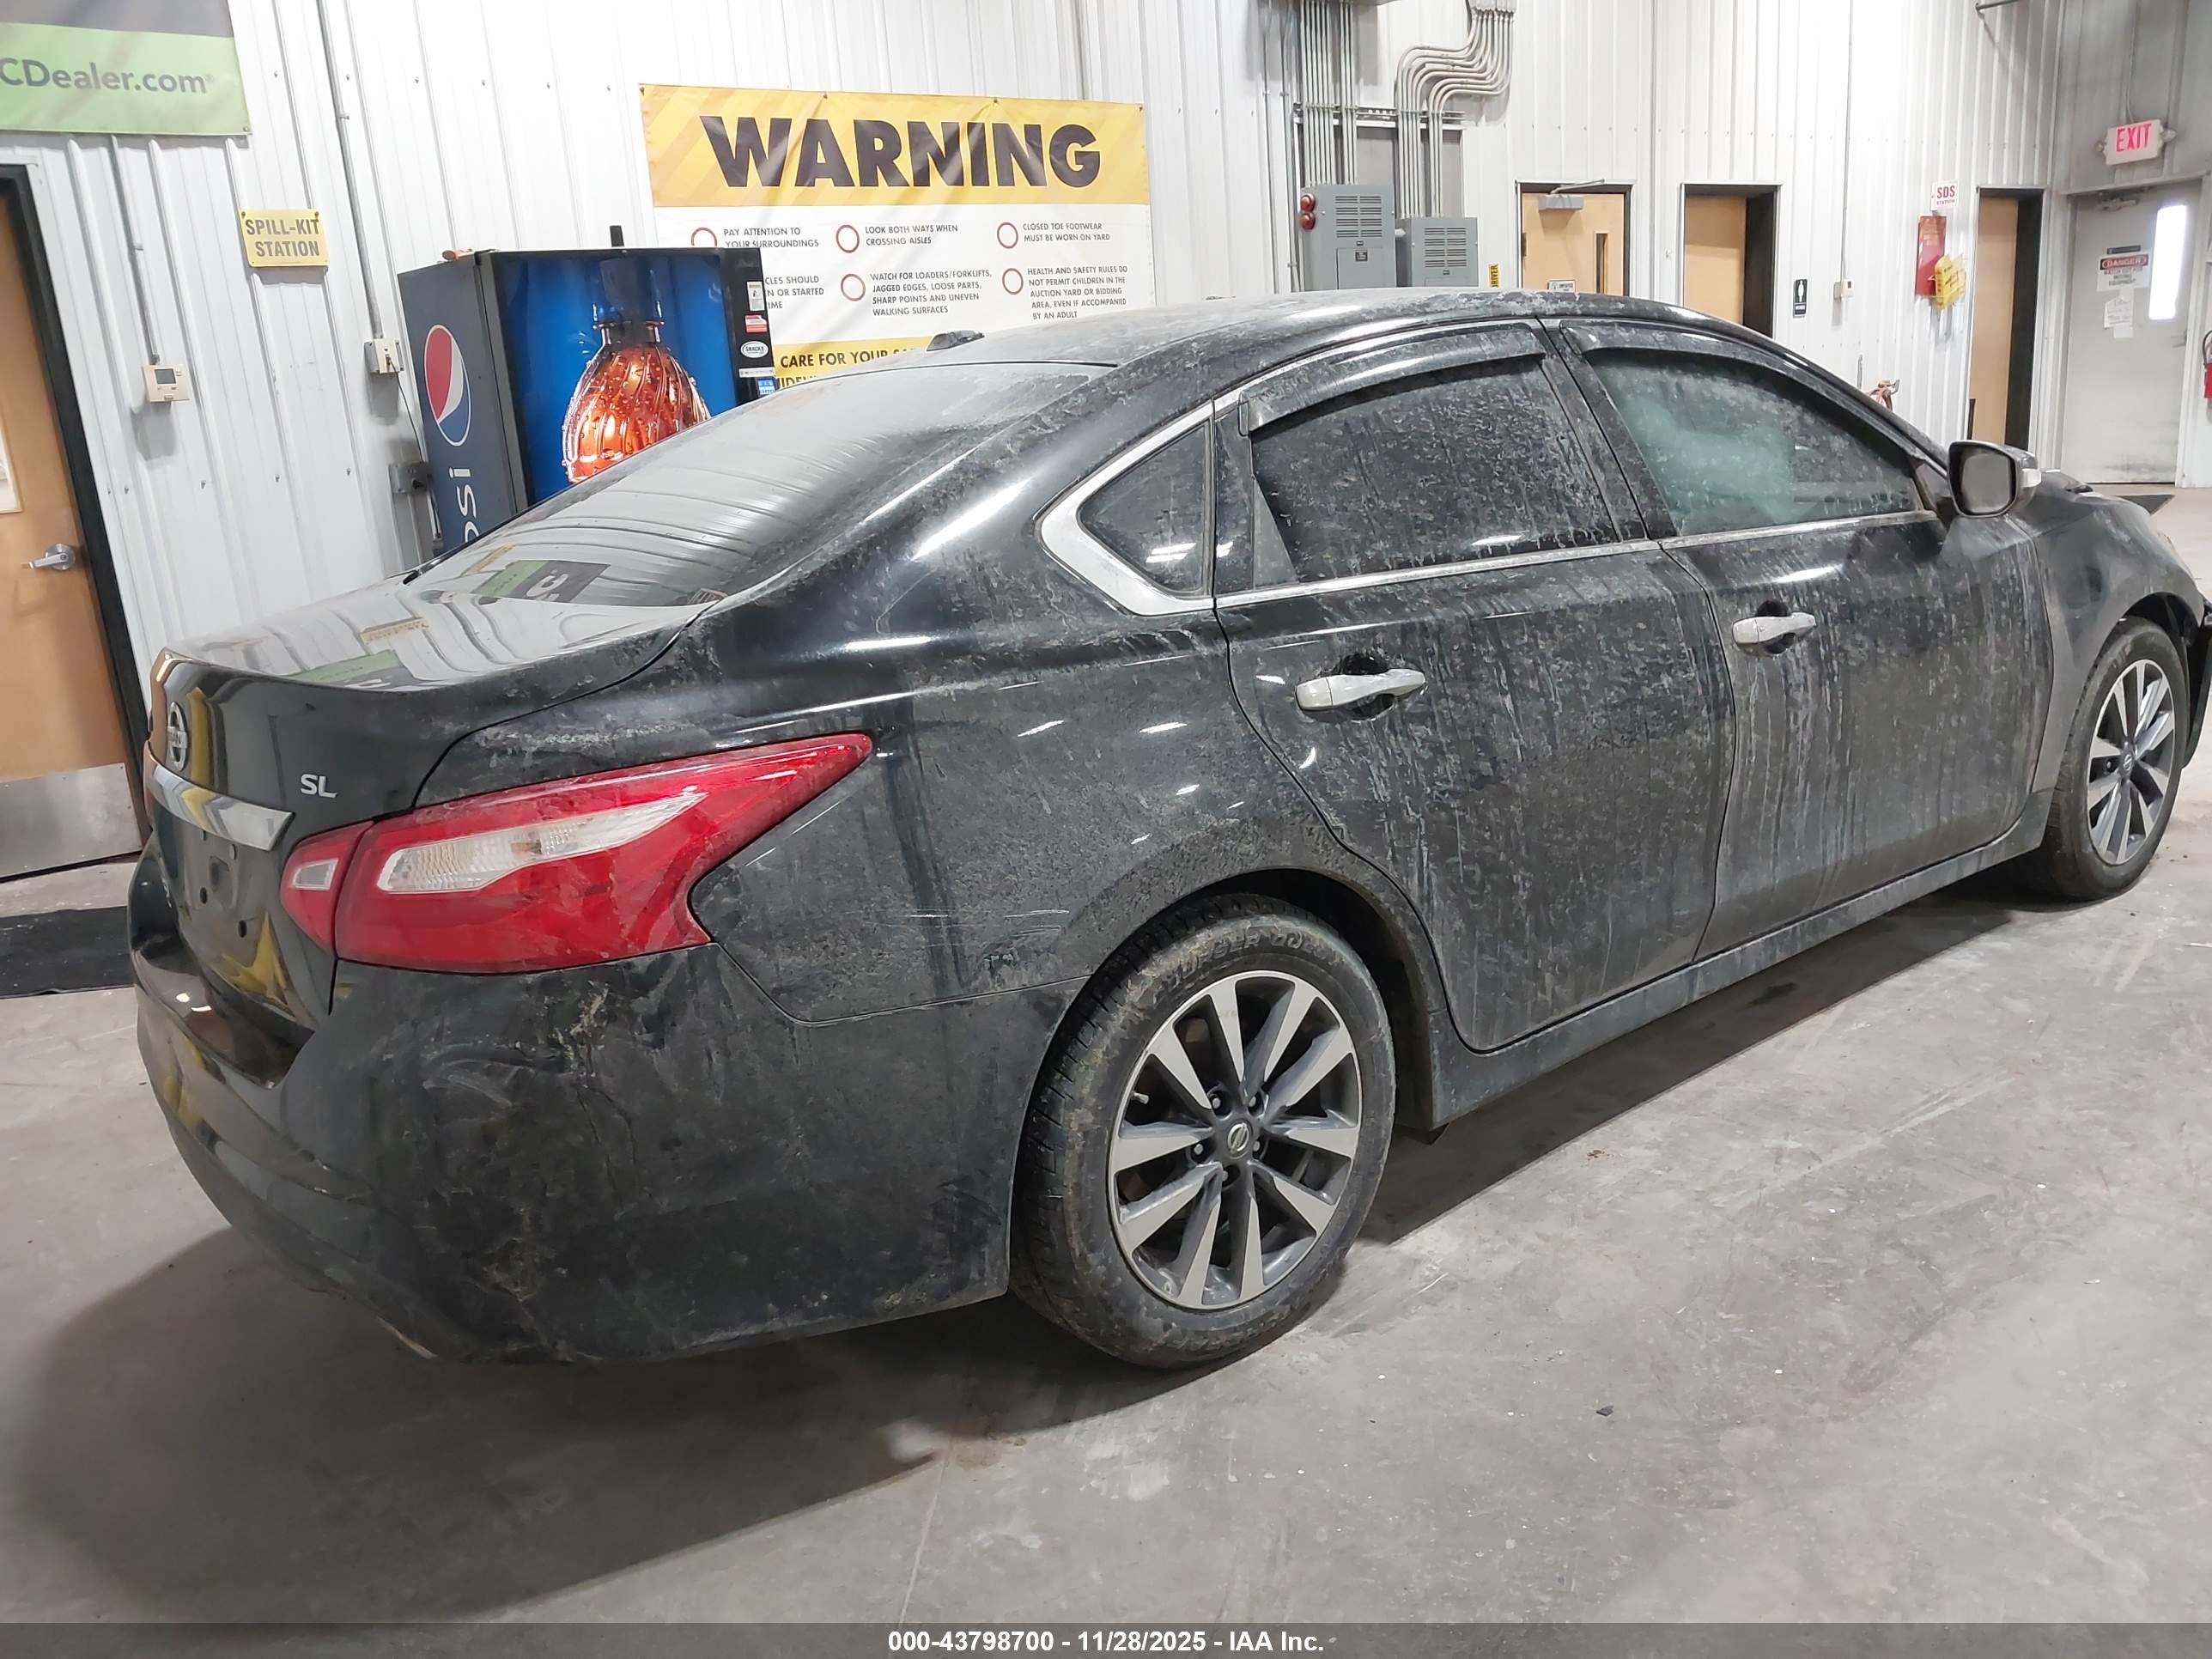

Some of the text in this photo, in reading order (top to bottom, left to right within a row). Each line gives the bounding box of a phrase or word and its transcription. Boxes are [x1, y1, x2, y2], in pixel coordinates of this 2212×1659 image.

[2116, 123, 2152, 152] EXIT
[699, 114, 1101, 188] WARNING
[1936, 185, 1955, 199] SDS
[245, 218, 319, 235] SPILL-KIT
[744, 228, 788, 236] ATTENTION
[790, 227, 801, 235] TO
[865, 226, 886, 234] LOOK
[888, 225, 910, 234] BOTH
[936, 224, 958, 233] WHEN
[1023, 222, 1049, 231] CLOSED
[751, 240, 819, 248] SURROUNDINGS
[866, 236, 932, 246] CROSSING AISLES
[255, 240, 320, 257] STATION
[870, 272, 897, 281] WATCH
[915, 270, 993, 279] LOADERS/FORKLIFTS,
[1027, 267, 1054, 276] HEALTH
[786, 276, 819, 284] SHOULD
[1072, 276, 1105, 285] CHILDREN
[792, 288, 824, 296] STARTED
[872, 284, 901, 293] JAGGED
[957, 281, 982, 289] PARTS,
[1030, 289, 1061, 298] AUCTION
[1096, 287, 1122, 295] BIDDING
[872, 296, 897, 305] SHARP
[929, 294, 947, 302] AND
[949, 293, 980, 301] UNEVEN
[1031, 301, 1052, 309] AREA,
[1073, 299, 1079, 307] IF
[1080, 298, 1127, 307] ACCOMPANIED
[872, 306, 949, 317] WALKING SURFACES
[780, 354, 814, 368] CARE
[818, 352, 847, 366] FOR
[300, 774, 337, 799] SL
